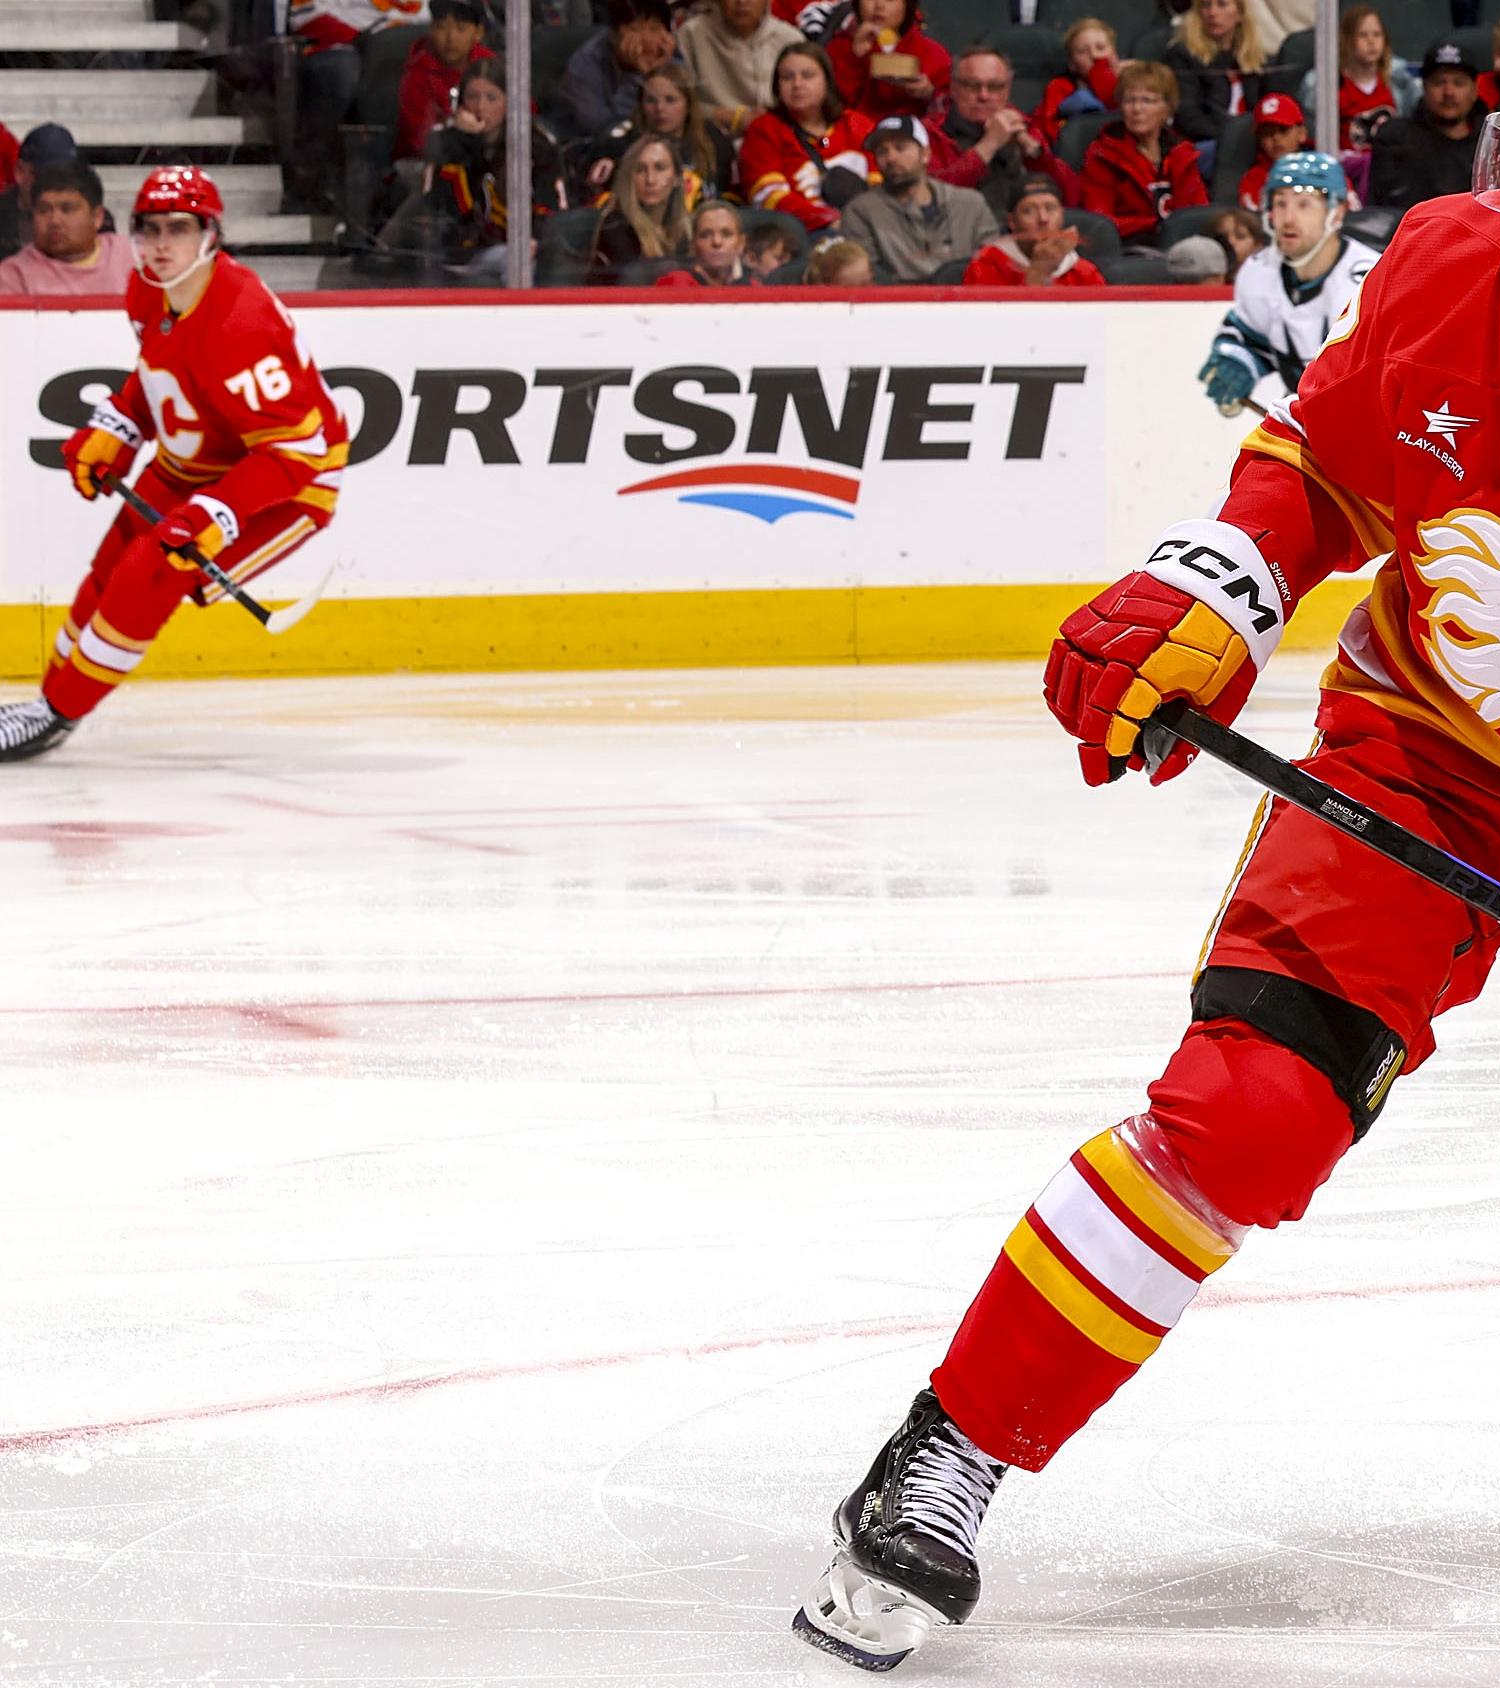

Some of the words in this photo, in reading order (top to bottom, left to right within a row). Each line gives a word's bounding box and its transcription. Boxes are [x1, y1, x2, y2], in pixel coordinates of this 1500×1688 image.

[224, 354, 292, 411] 76
[28, 364, 1087, 470] SORTSNET
[1146, 540, 1280, 635] CCM
[1269, 561, 1292, 602] SHARKY
[1324, 797, 1370, 826] NANOLITE
